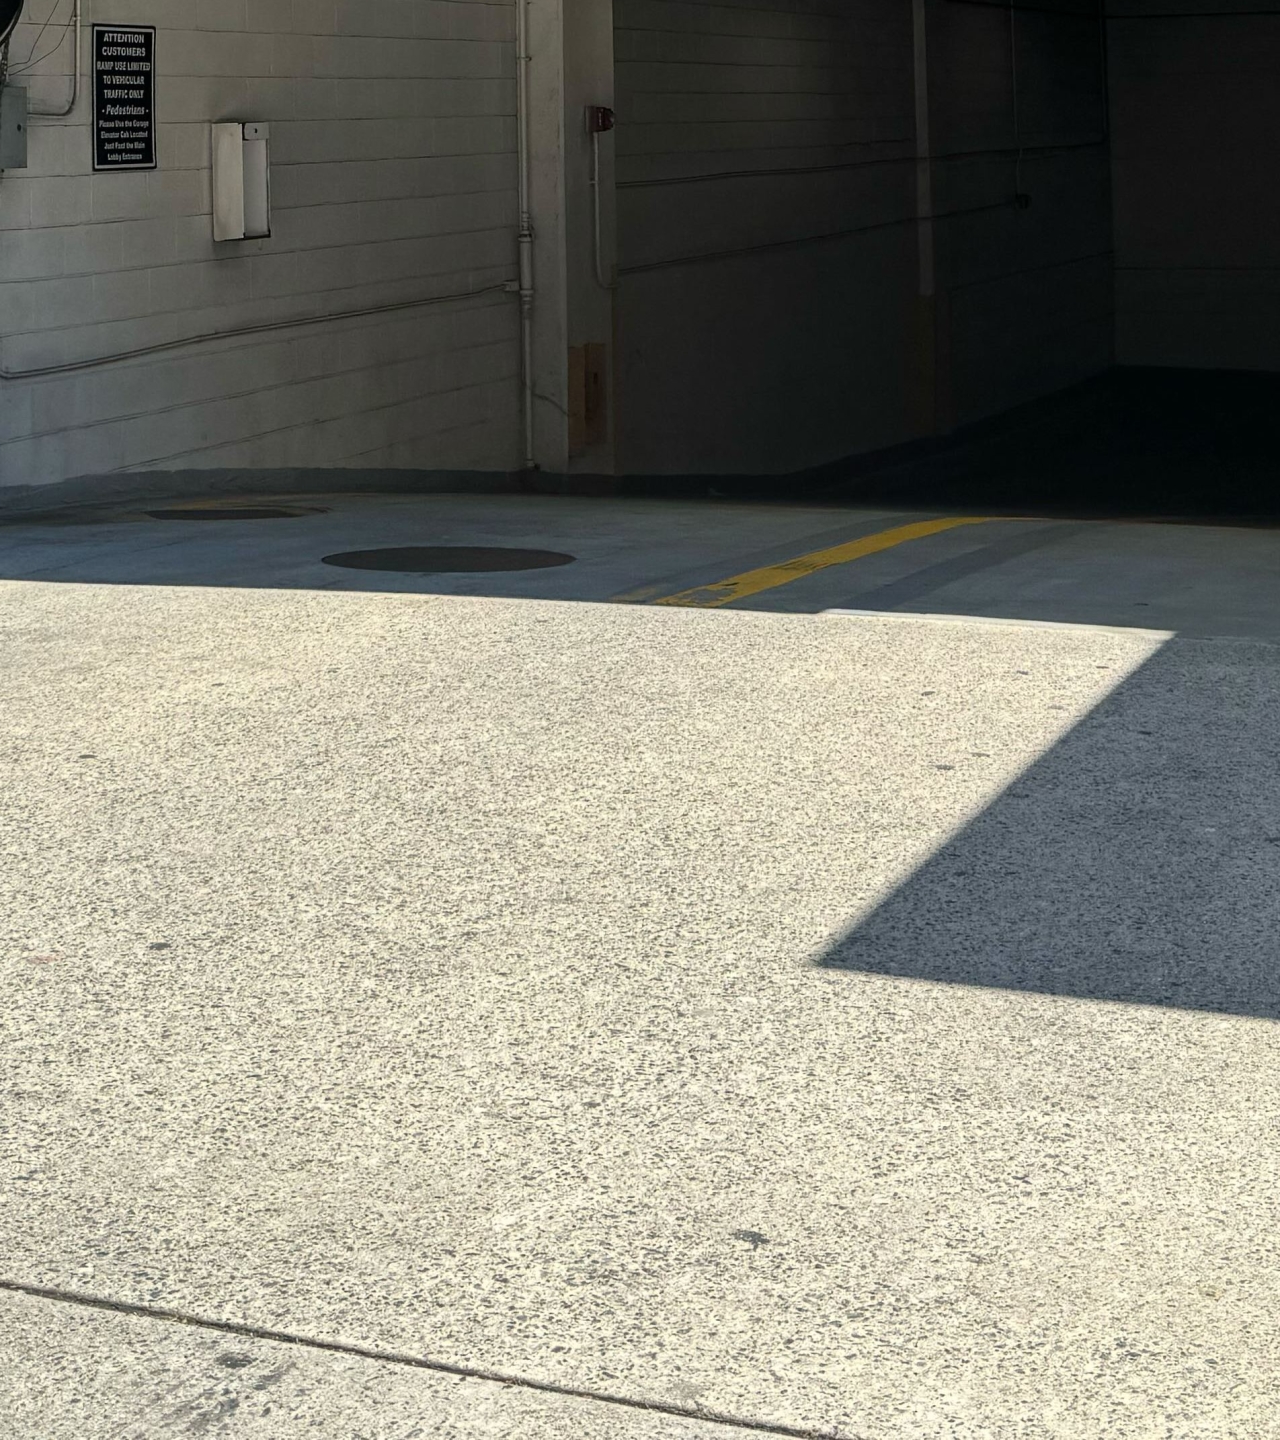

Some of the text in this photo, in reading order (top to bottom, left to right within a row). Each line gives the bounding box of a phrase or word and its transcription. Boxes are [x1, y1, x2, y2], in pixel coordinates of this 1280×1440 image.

[104, 33, 145, 43] ATTENTION
[102, 47, 146, 56] CUSTOMERS
[97, 61, 150, 71] RAMP USE LIMITED
[103, 76, 145, 84] TO VEHICULAR
[104, 90, 144, 98] TRAFFIC ONLY
